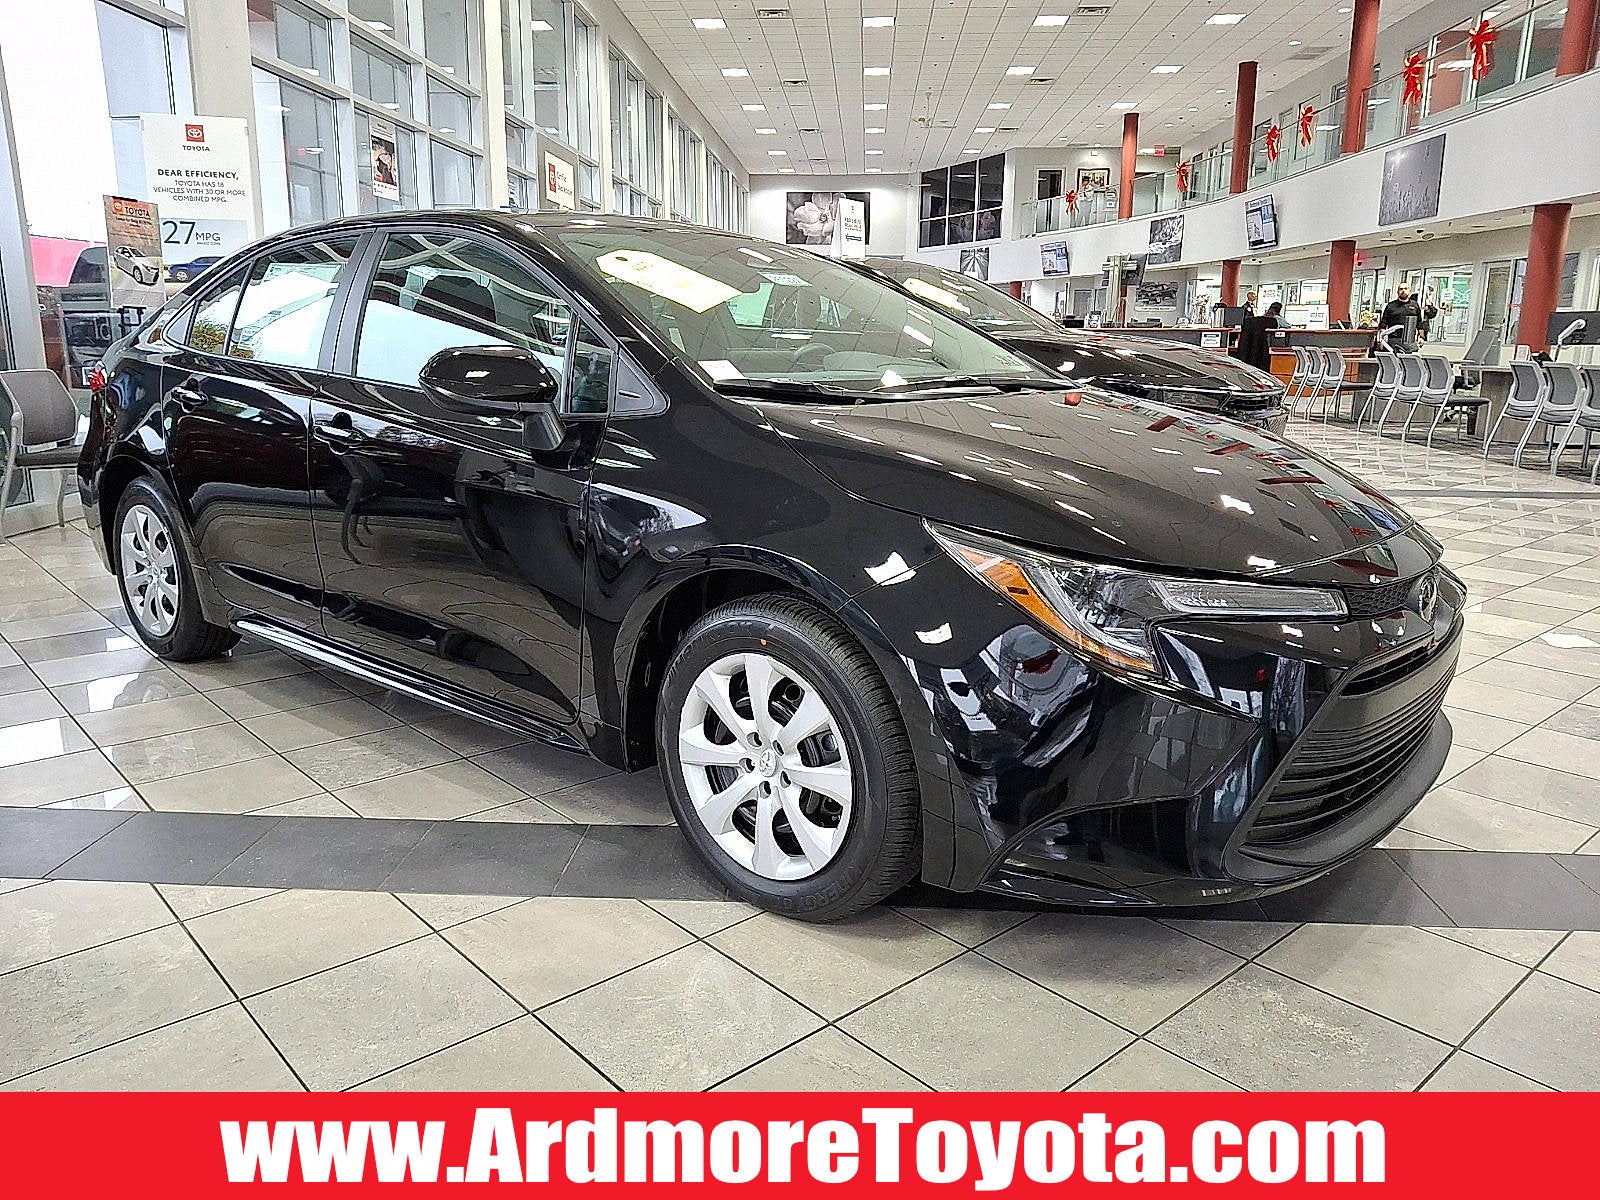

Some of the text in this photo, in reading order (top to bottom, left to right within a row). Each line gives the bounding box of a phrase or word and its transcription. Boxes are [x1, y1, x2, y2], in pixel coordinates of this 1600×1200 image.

[157, 168, 239, 180] DEAR EFFICIENCY,
[124, 206, 151, 217] TOYOTA
[162, 220, 196, 245] 27
[195, 231, 221, 242] MPG
